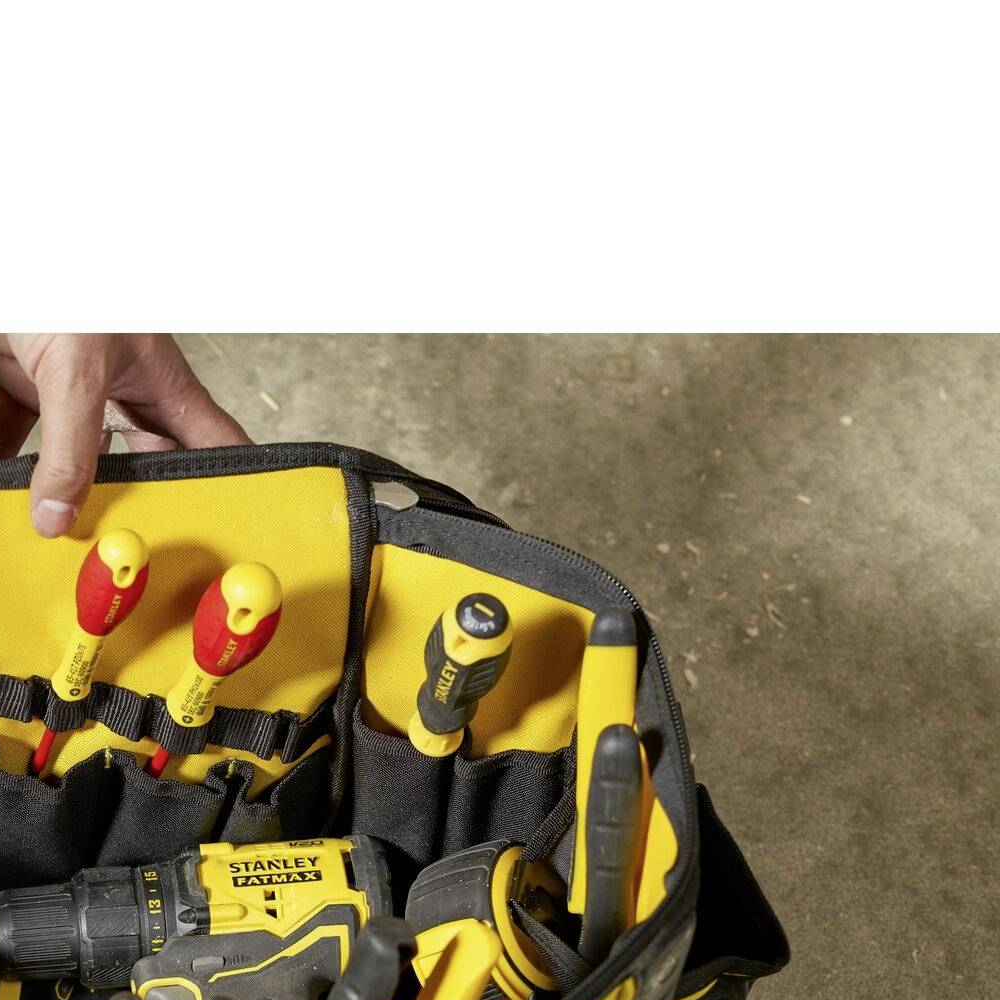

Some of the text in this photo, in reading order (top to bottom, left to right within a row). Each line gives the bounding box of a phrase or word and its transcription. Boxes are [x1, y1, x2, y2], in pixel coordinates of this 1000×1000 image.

[104, 594, 122, 624] STANLEY
[216, 638, 239, 668] STANLEY
[434, 660, 458, 705] STANLEY
[229, 856, 320, 874] STANLEY
[144, 871, 159, 881] 15
[235, 871, 320, 887] FATMAX
[148, 899, 162, 914] 13
